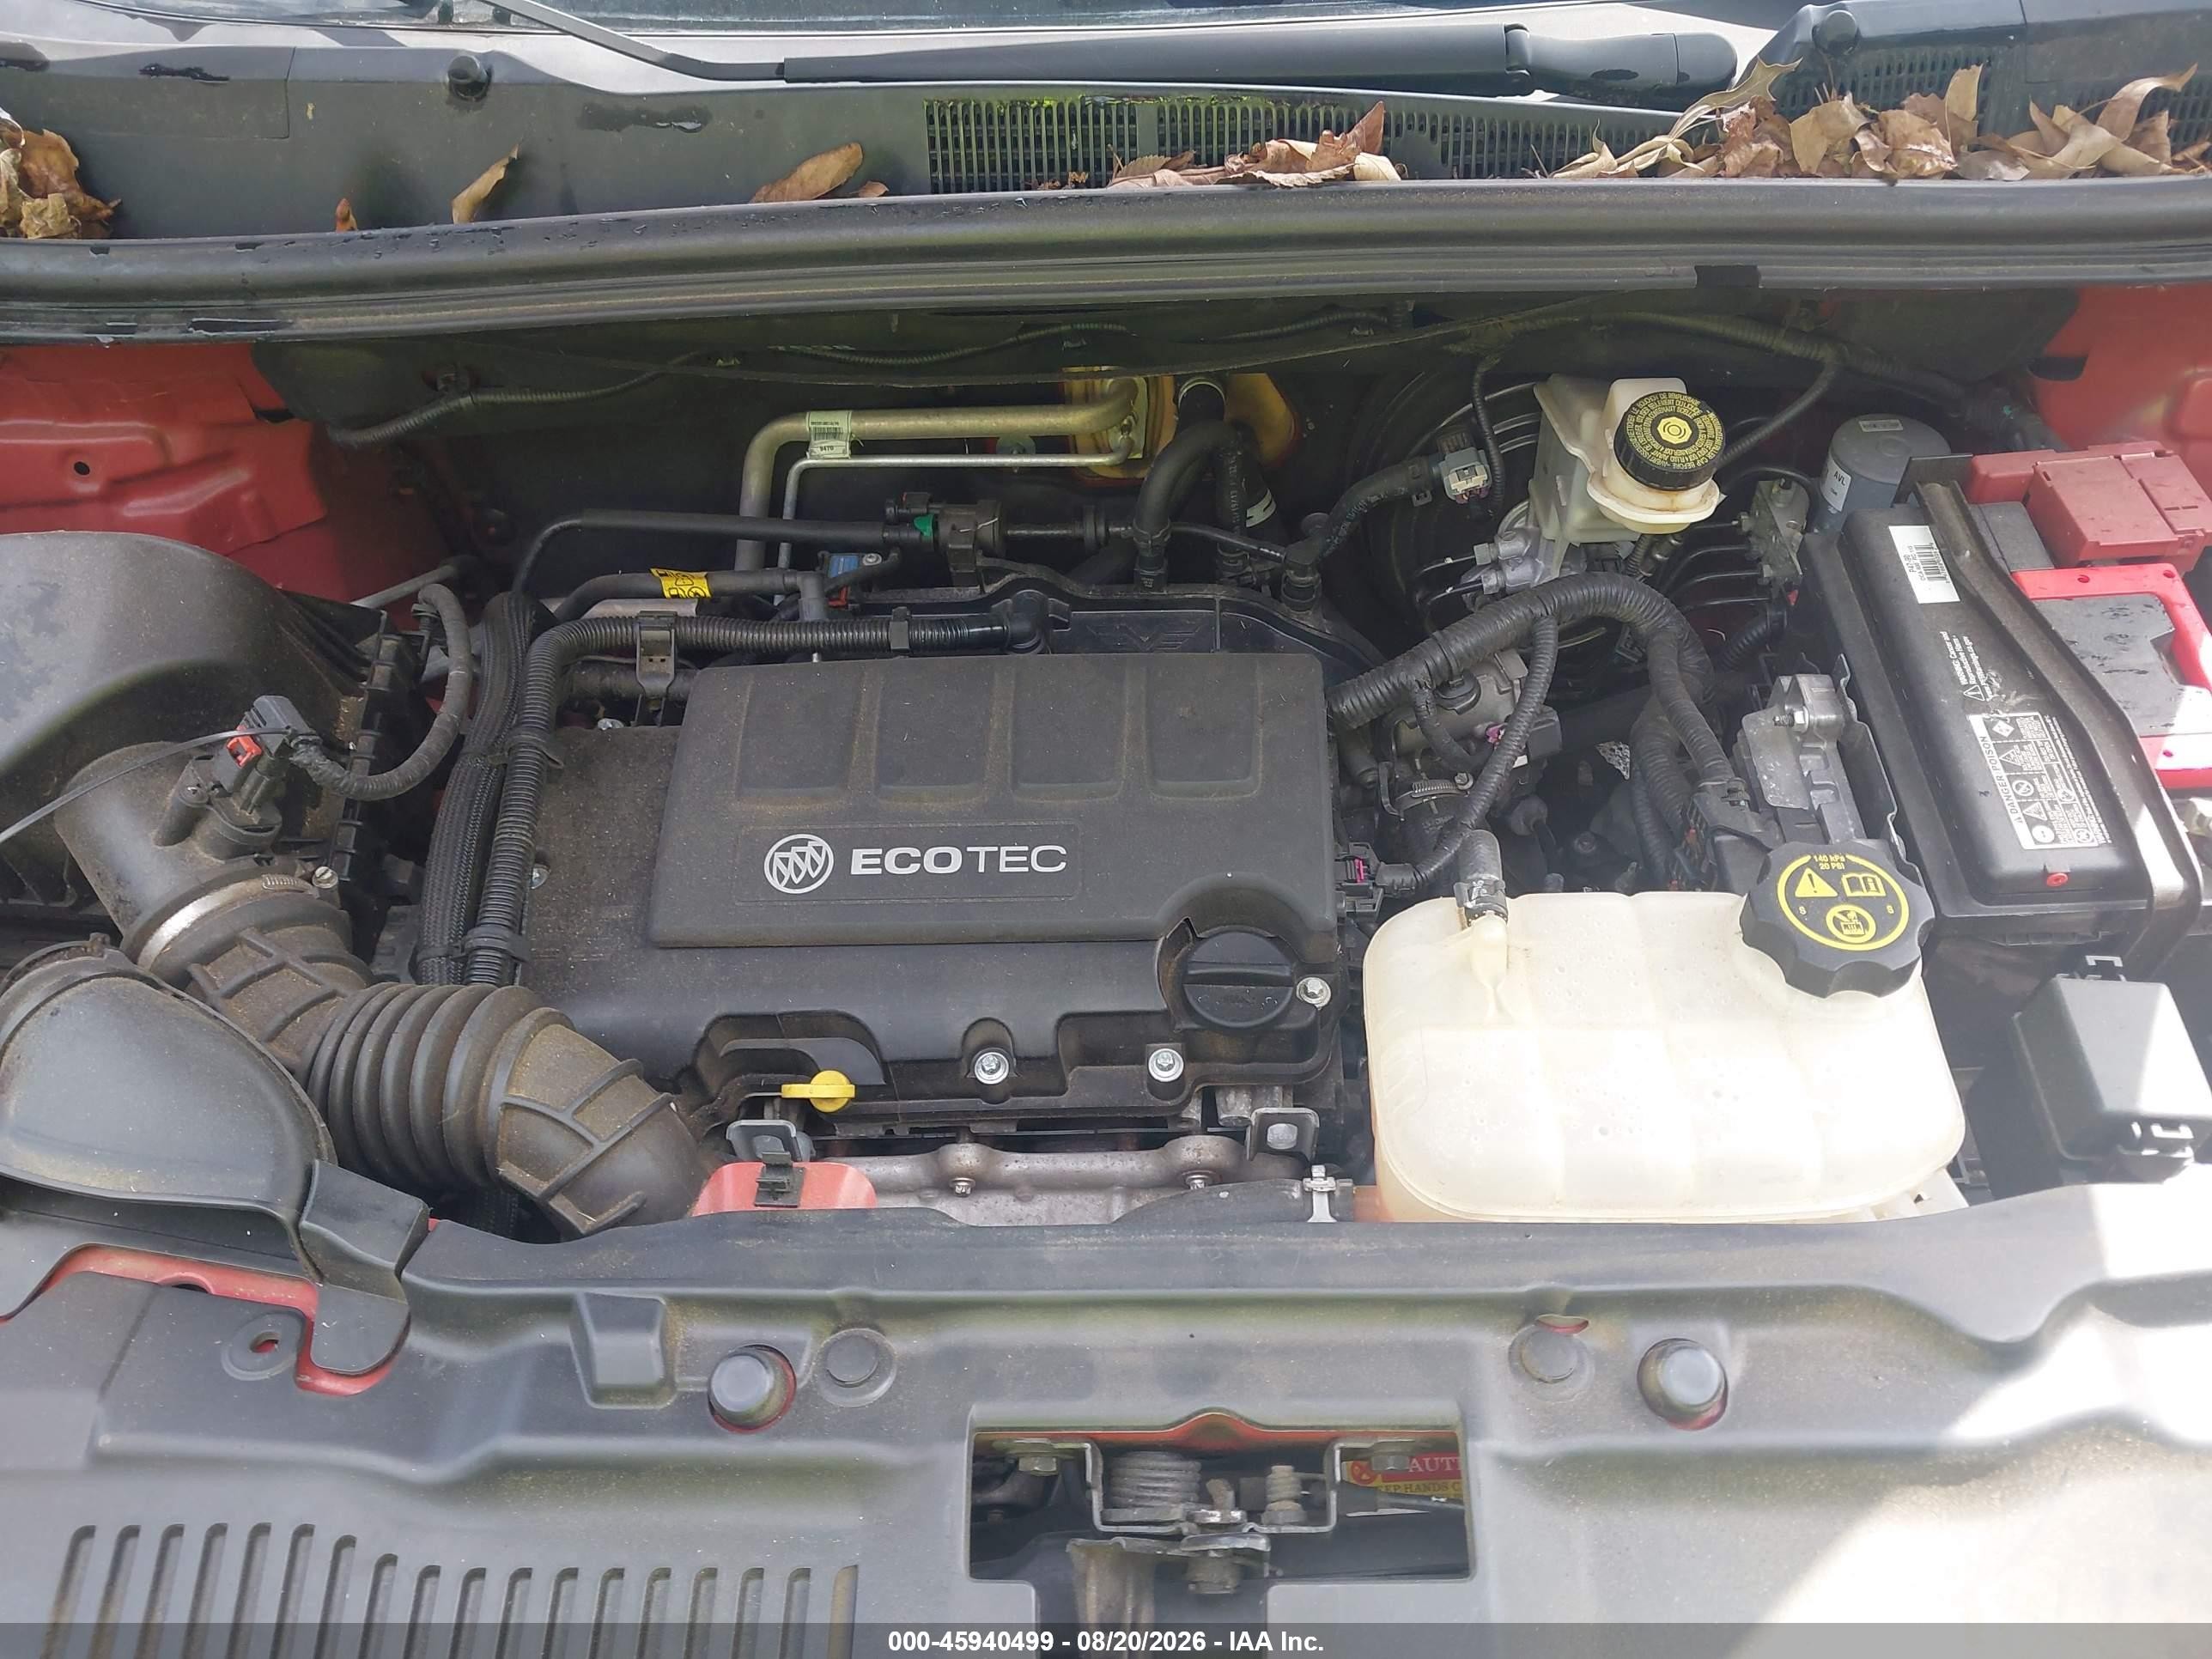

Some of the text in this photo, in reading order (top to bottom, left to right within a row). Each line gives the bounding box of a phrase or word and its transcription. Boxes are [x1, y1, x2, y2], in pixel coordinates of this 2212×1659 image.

[1978, 735, 2002, 772] POISON
[1995, 775, 2019, 815] DANGER
[851, 845, 1067, 875] ECOTEC
